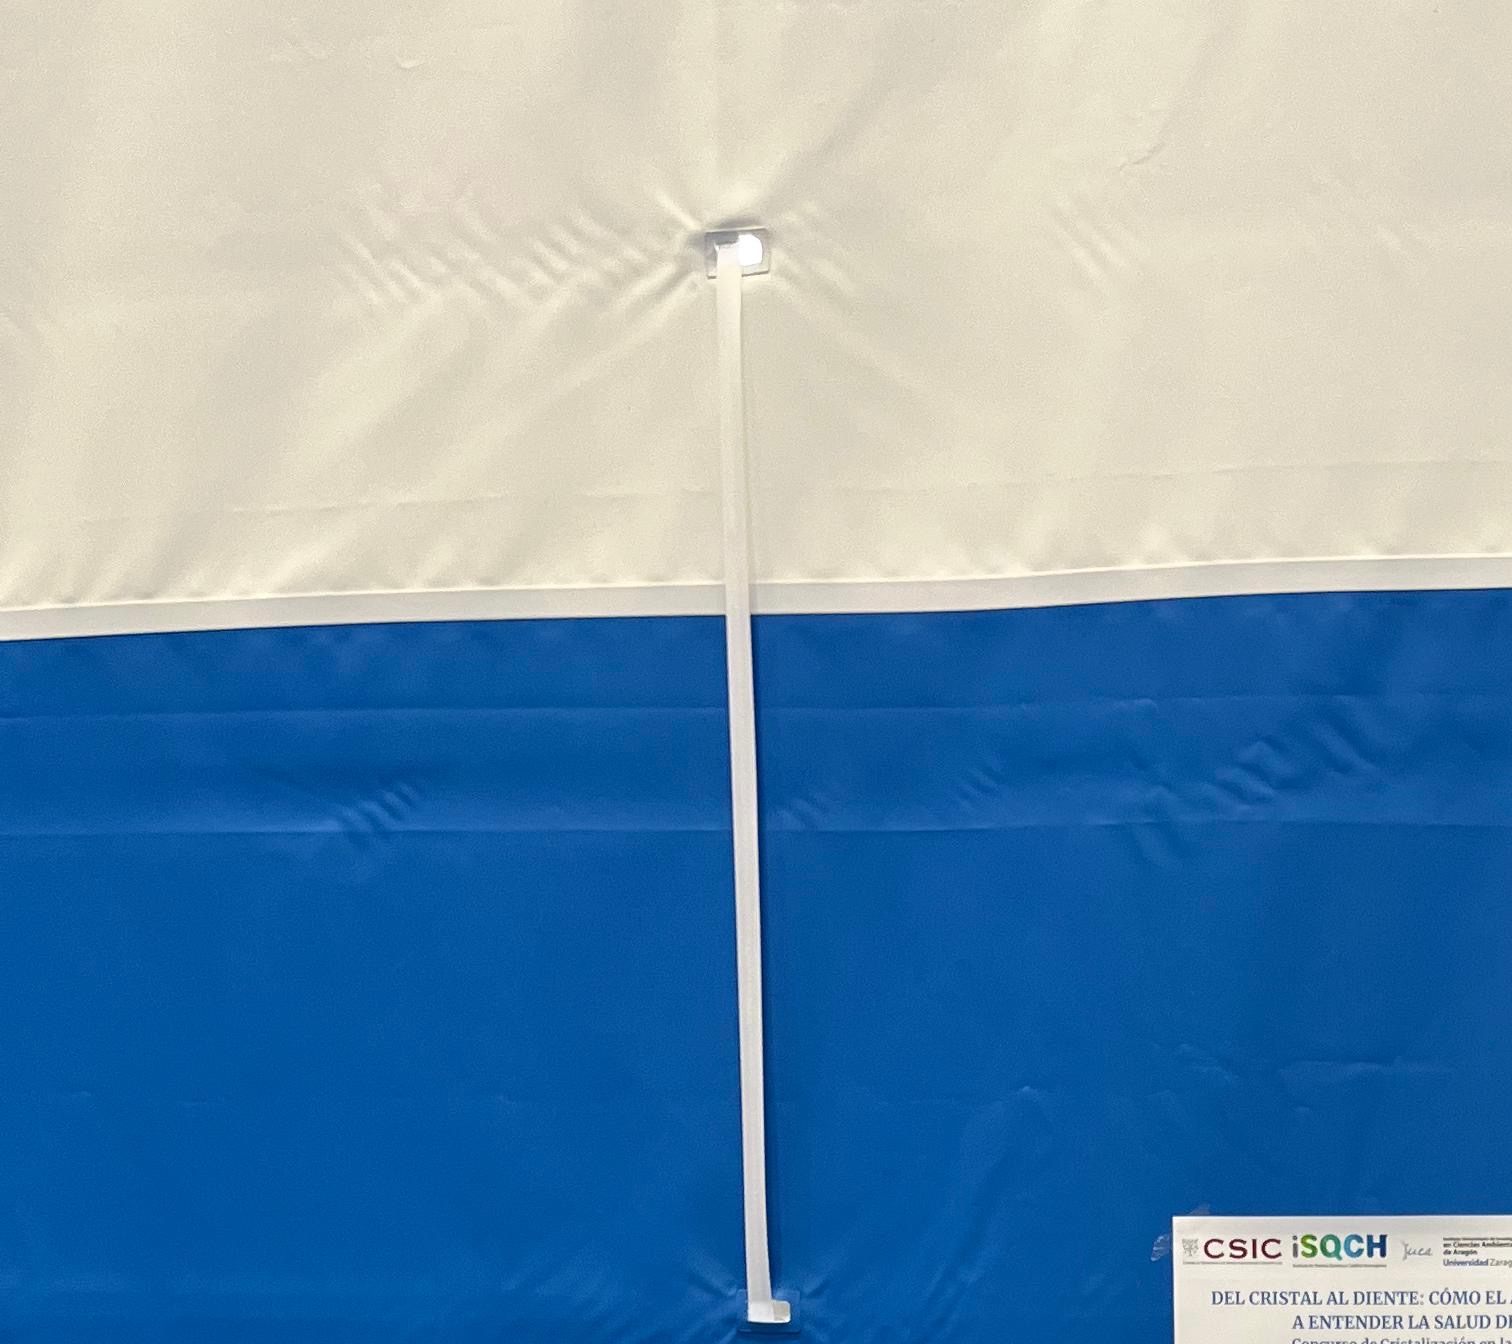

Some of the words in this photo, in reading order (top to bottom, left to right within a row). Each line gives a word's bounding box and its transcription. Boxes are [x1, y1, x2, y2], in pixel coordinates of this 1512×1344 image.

[1203, 1237, 1282, 1259] CSIC
[1211, 1290, 1245, 1305] DEL
[1248, 1290, 1322, 1305] CRISTAL
[1326, 1290, 1349, 1305] AL
[1352, 1290, 1425, 1305] DIENTE:
[1428, 1287, 1481, 1305] CÓMO
[1485, 1289, 1506, 1305] EL
[1291, 1314, 1304, 1329] A
[1307, 1314, 1403, 1329] ENTENDER
[1407, 1314, 1430, 1329] LA
[1433, 1314, 1491, 1329] SALUD
